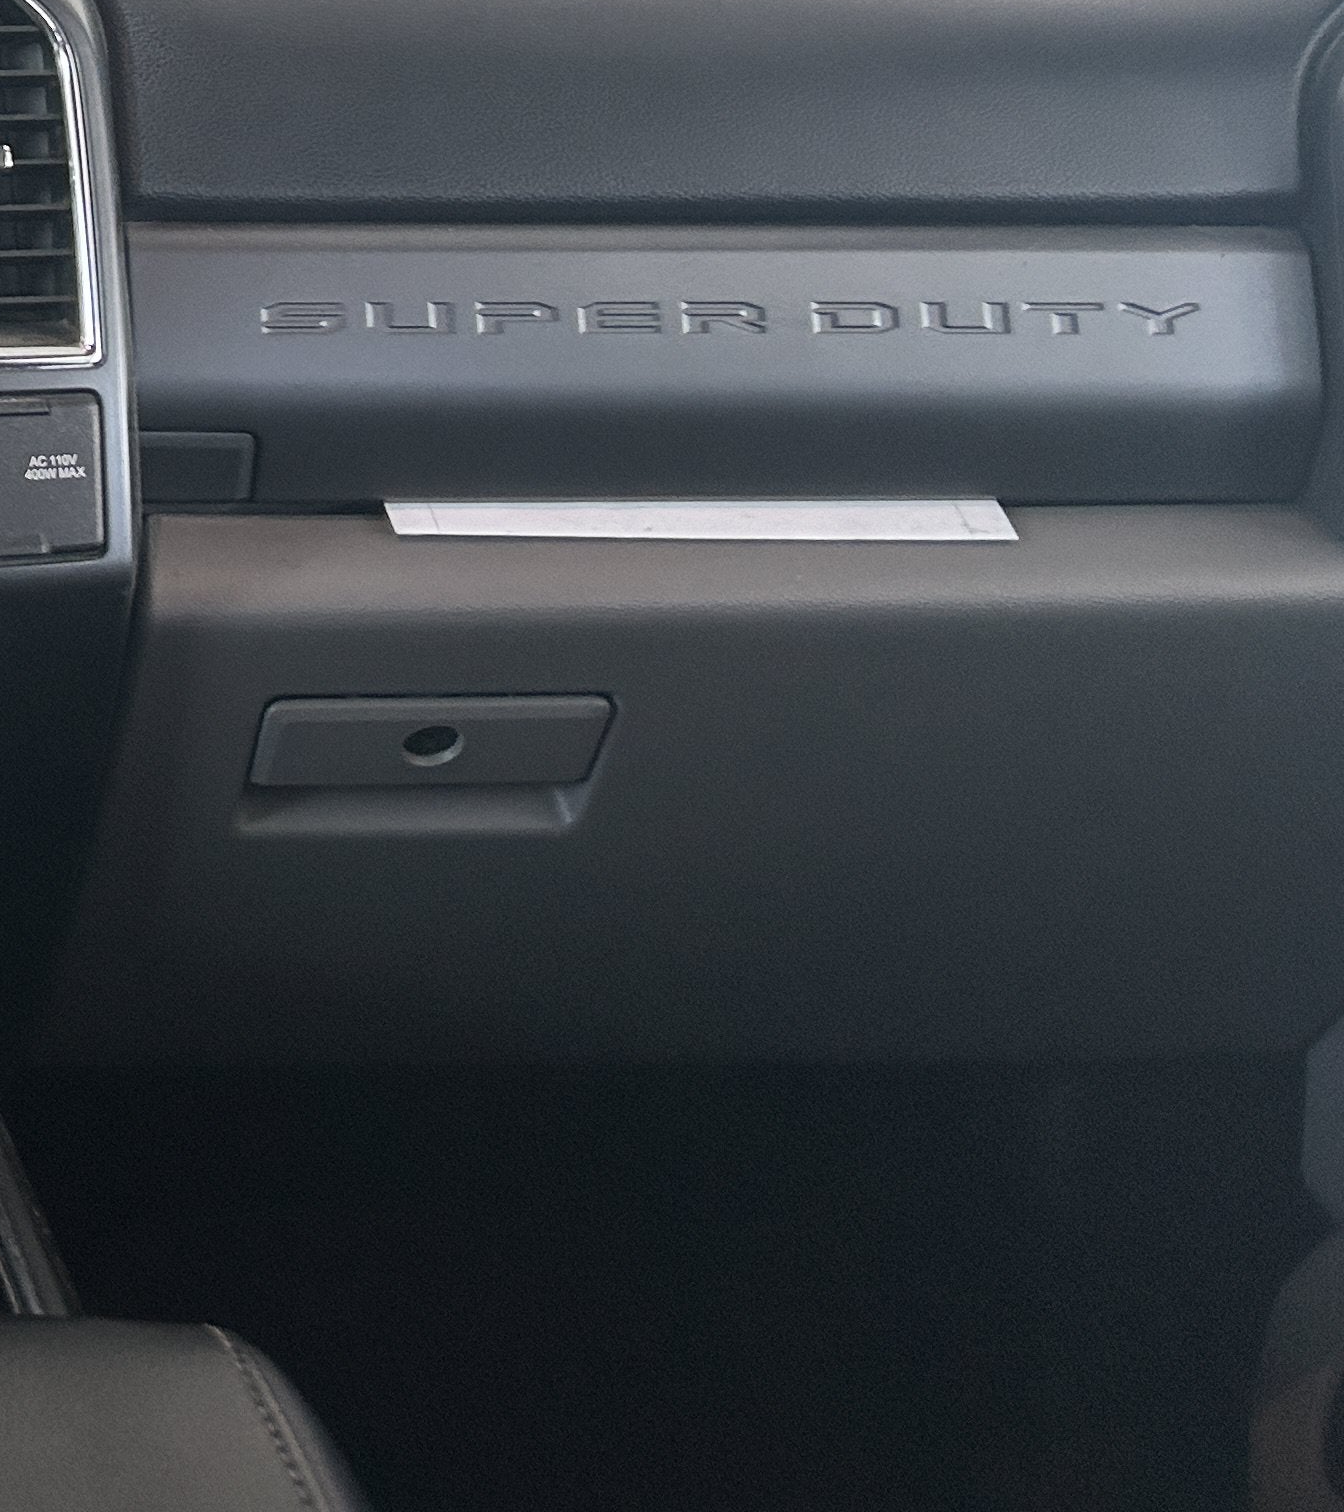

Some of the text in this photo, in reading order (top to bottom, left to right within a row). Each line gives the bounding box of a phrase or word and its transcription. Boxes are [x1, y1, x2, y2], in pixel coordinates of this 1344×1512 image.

[259, 300, 1202, 335] SUPER DUTY
[28, 453, 78, 467] AC 110V
[24, 466, 87, 480] 400W MAX
